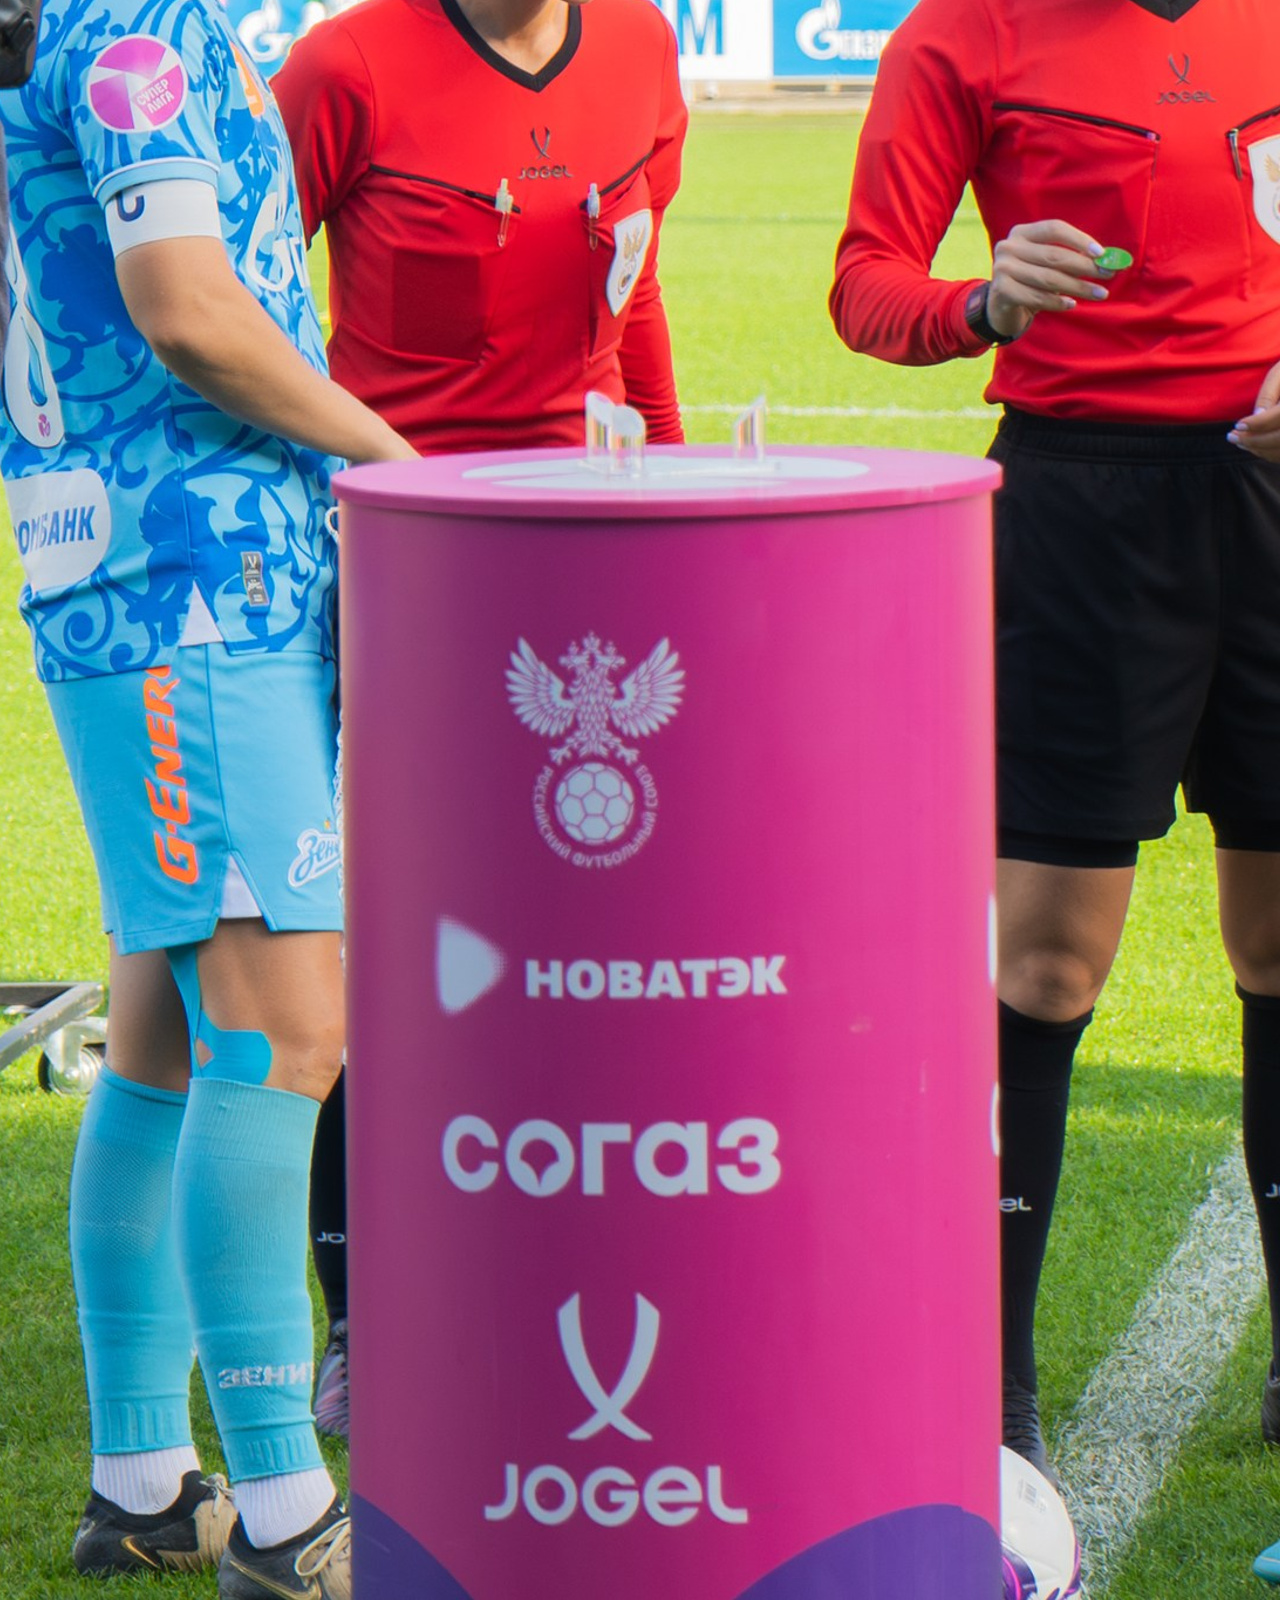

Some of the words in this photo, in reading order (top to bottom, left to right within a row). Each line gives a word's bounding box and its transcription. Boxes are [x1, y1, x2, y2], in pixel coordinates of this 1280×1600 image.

[136, 79, 169, 106] СУПЕР
[147, 90, 175, 115] ЛИГА
[14, 505, 96, 556] ОМБАНК
[533, 764, 572, 859] РОССИЙСКИЙ
[571, 810, 657, 868] ФУТБОЛЬНЫЙ
[634, 763, 659, 809] СОЮЗ
[525, 955, 788, 1000] НОВАТЭК
